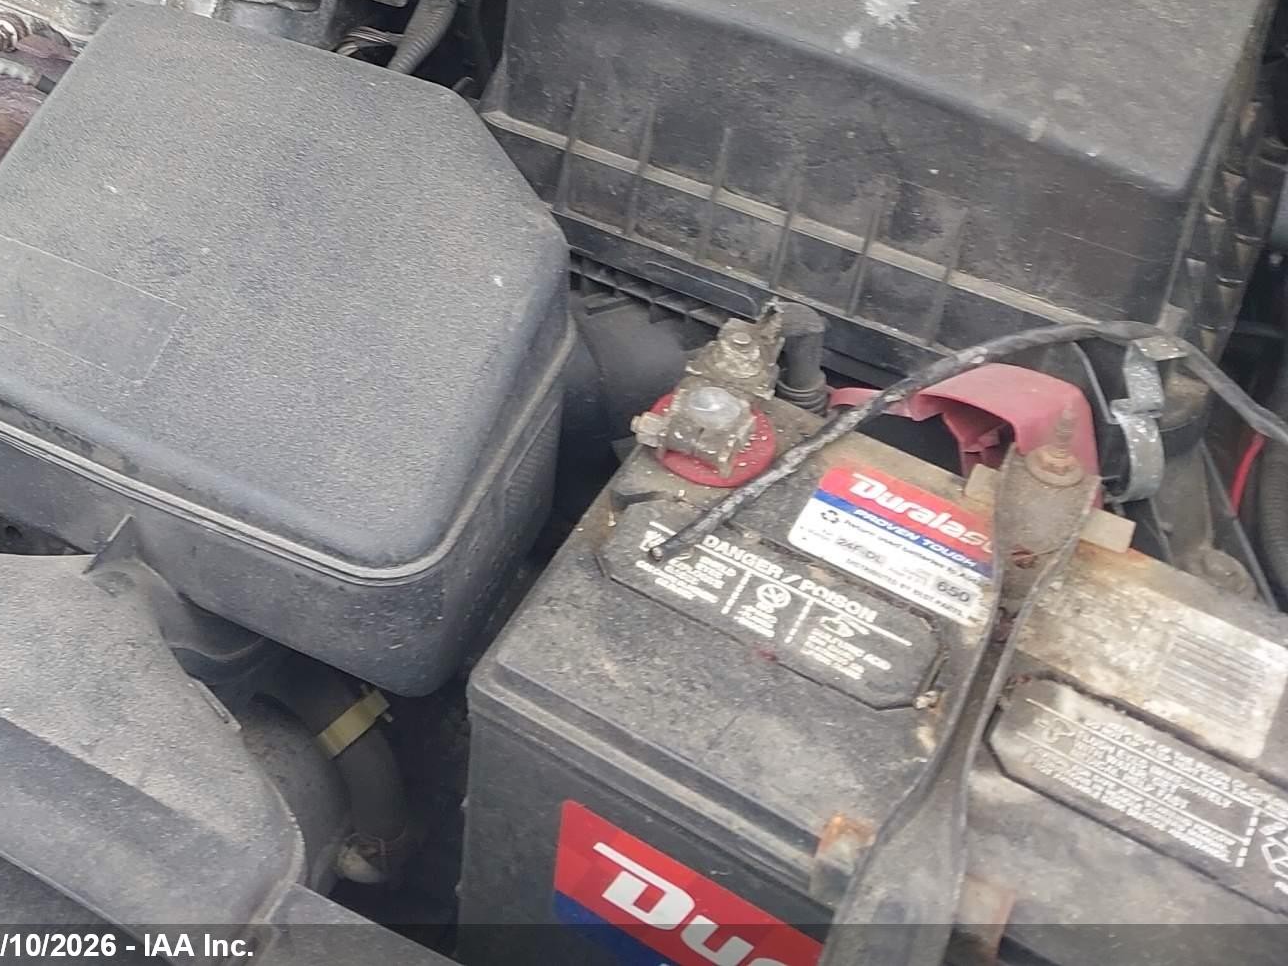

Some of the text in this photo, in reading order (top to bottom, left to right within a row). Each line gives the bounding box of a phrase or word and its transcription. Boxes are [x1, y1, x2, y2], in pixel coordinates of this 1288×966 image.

[853, 509, 918, 540] PROVEN
[922, 540, 977, 566] TOUGH
[703, 535, 784, 575] DANGER
[799, 579, 877, 622] POISON
[936, 580, 968, 603] 650
[593, 841, 790, 966] Du
